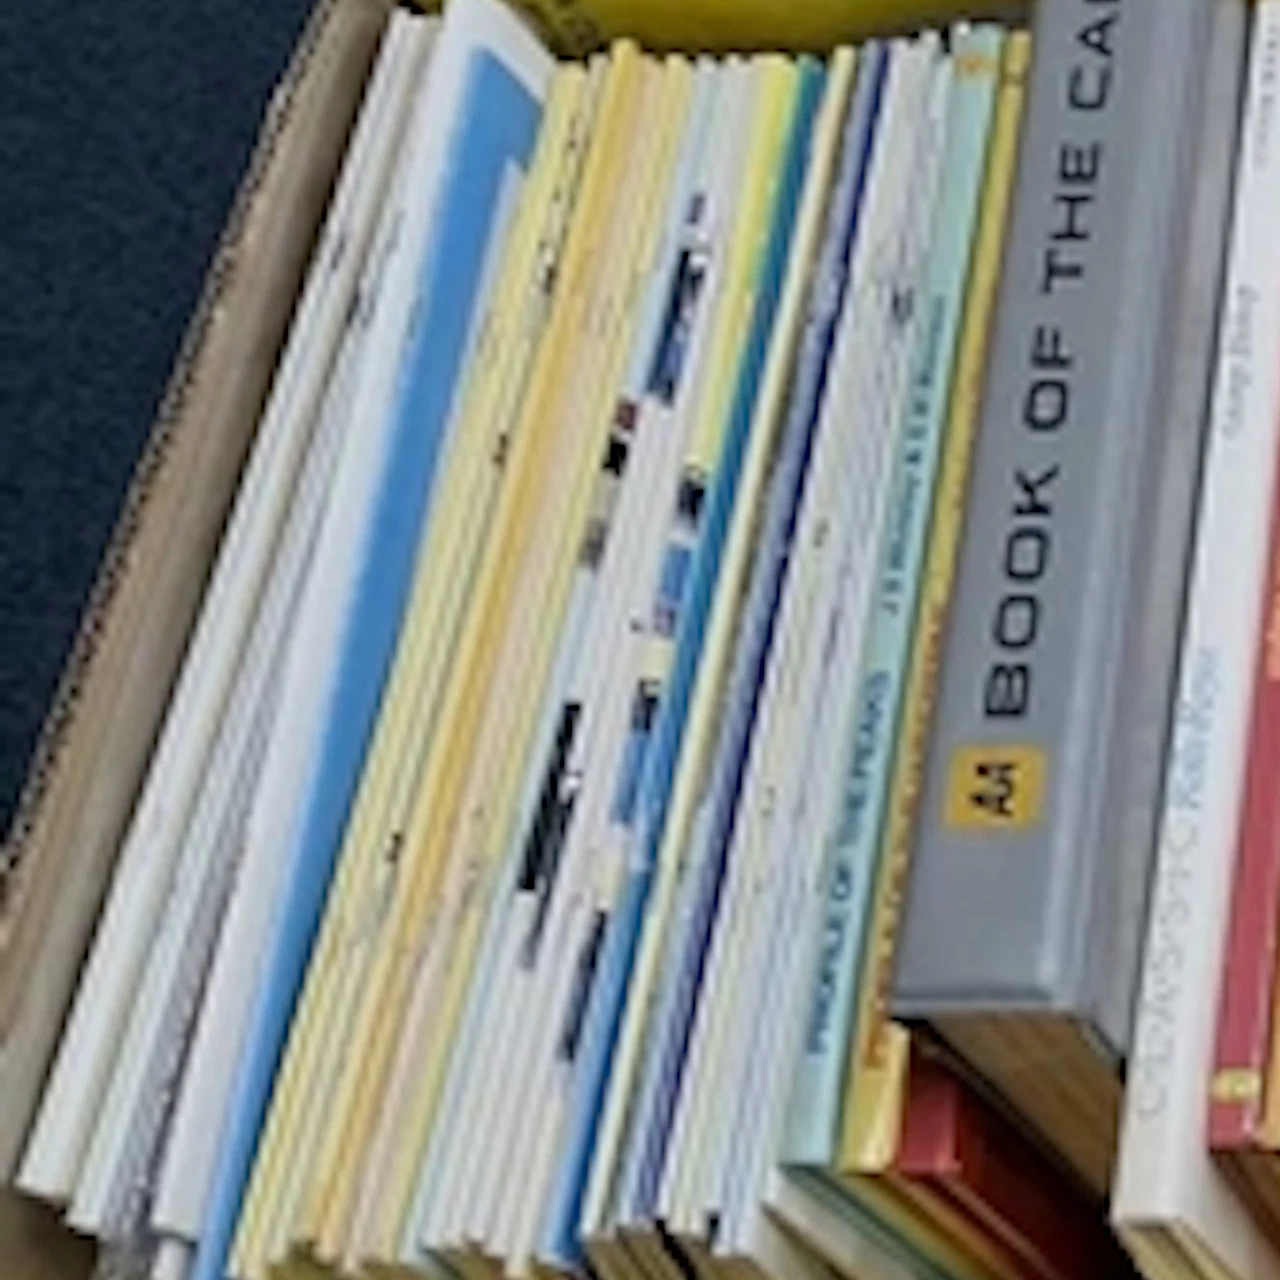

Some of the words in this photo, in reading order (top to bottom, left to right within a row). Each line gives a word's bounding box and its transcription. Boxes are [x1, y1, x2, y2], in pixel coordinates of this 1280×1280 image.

[1041, 139, 1104, 295] THE
[1023, 322, 1080, 433] OF
[984, 461, 1063, 721] BOOK
